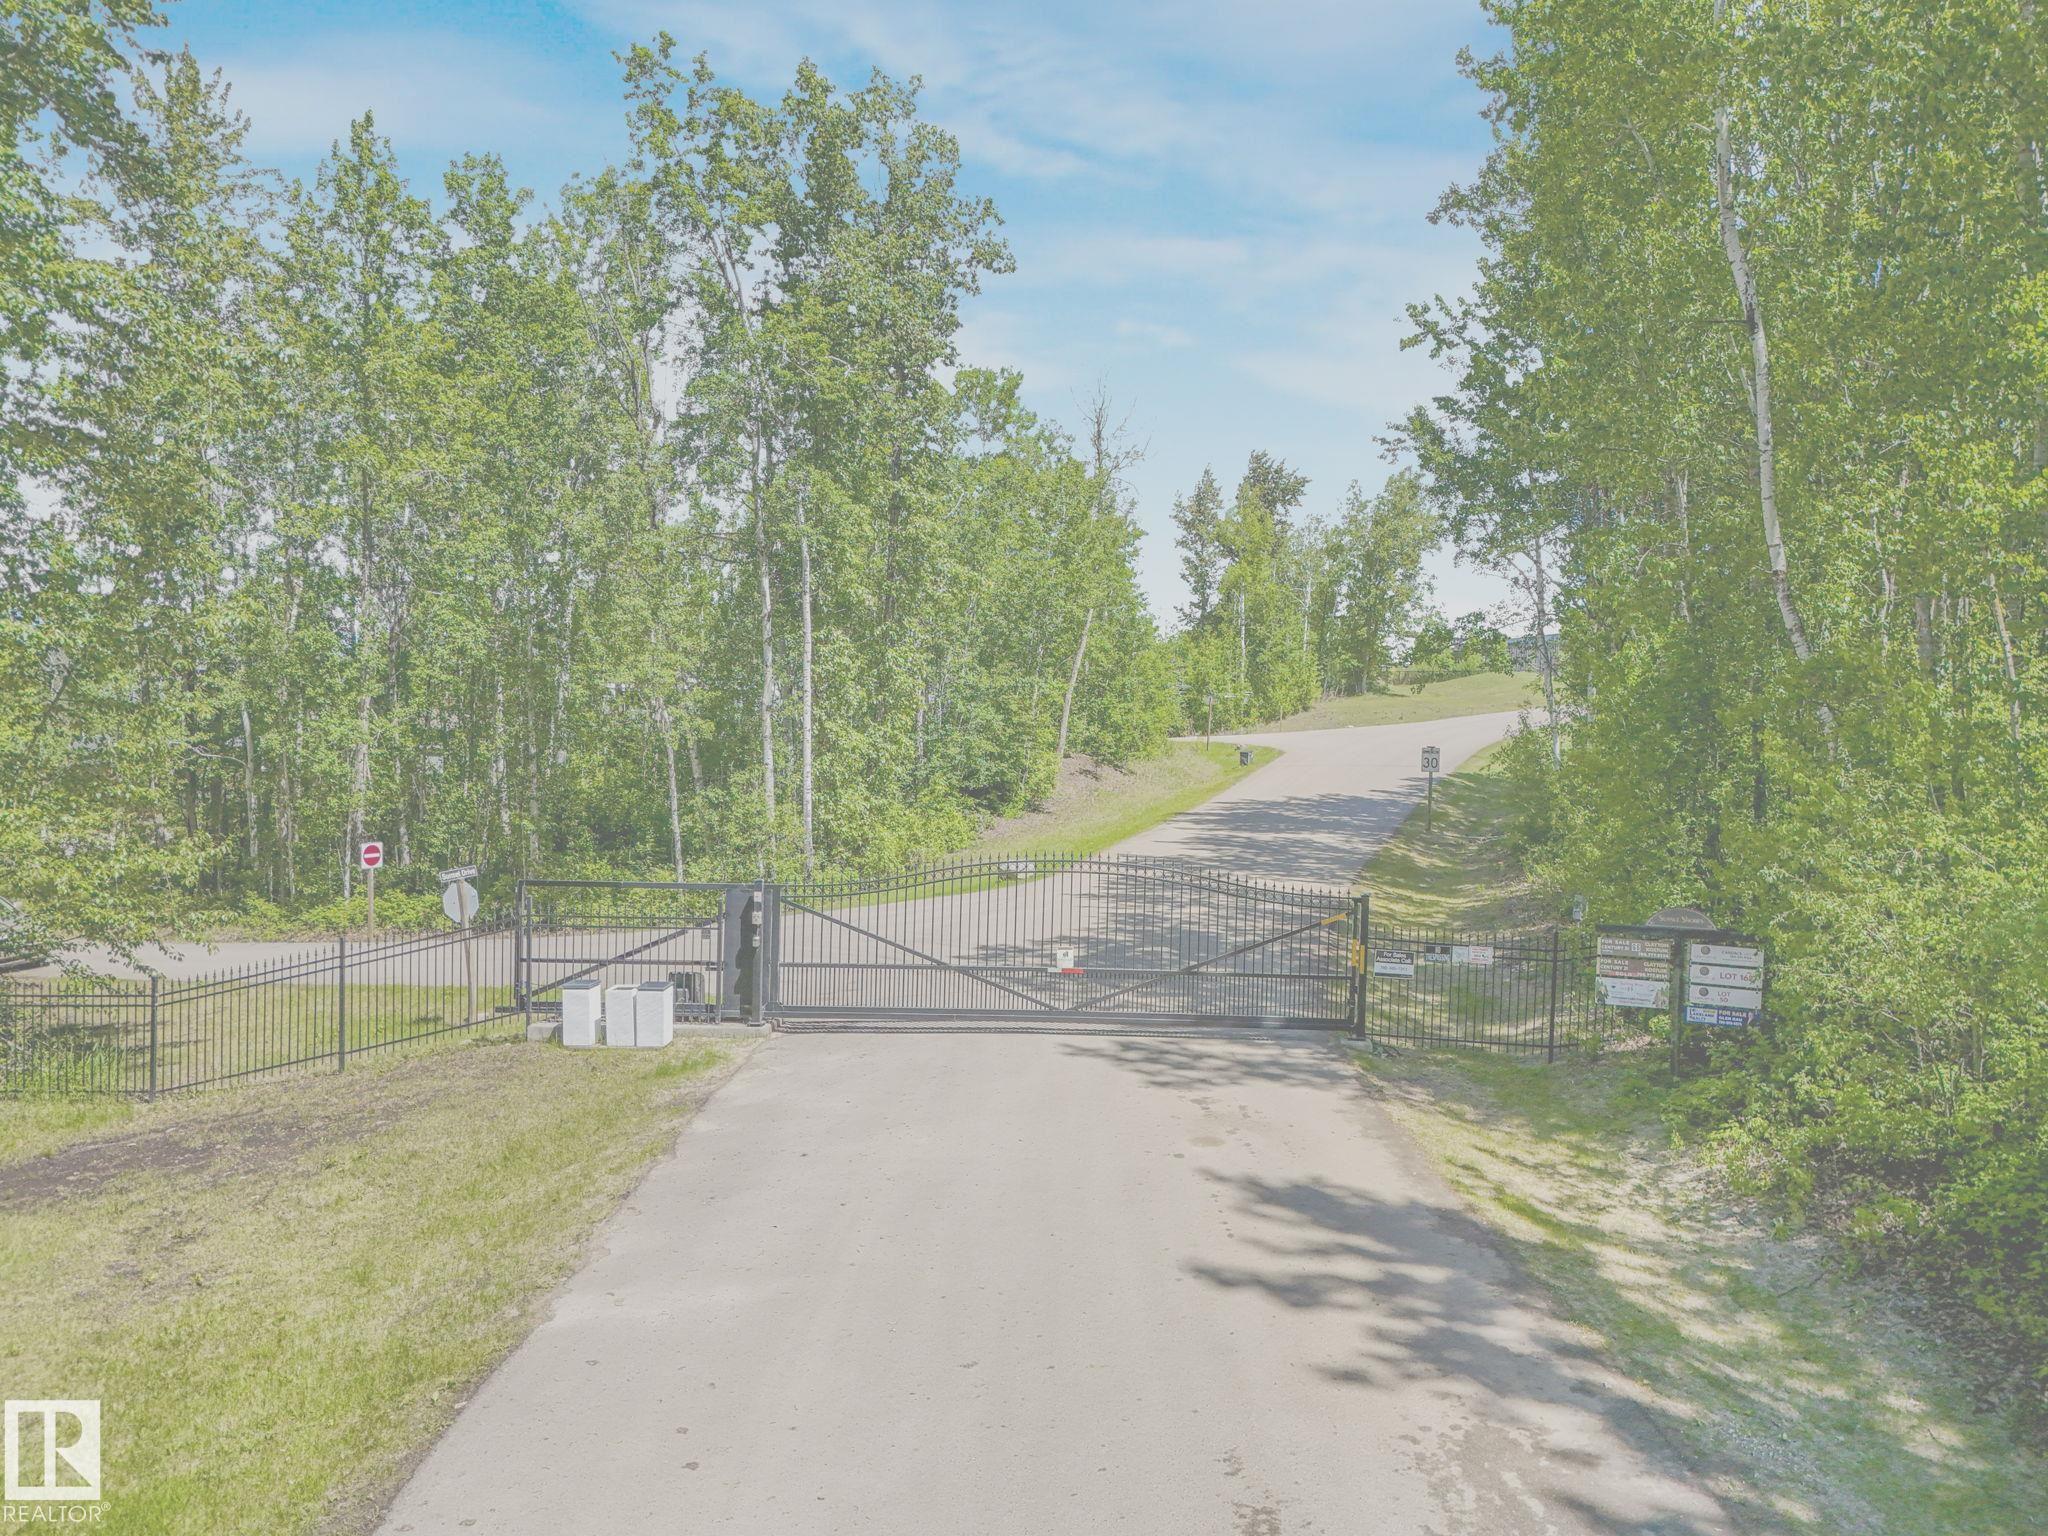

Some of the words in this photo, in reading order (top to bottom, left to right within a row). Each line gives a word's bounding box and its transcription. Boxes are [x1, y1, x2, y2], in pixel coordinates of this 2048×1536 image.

[1423, 757, 1438, 769] 30
[461, 868, 476, 877] Drive
[1720, 972, 1737, 980] LOT
